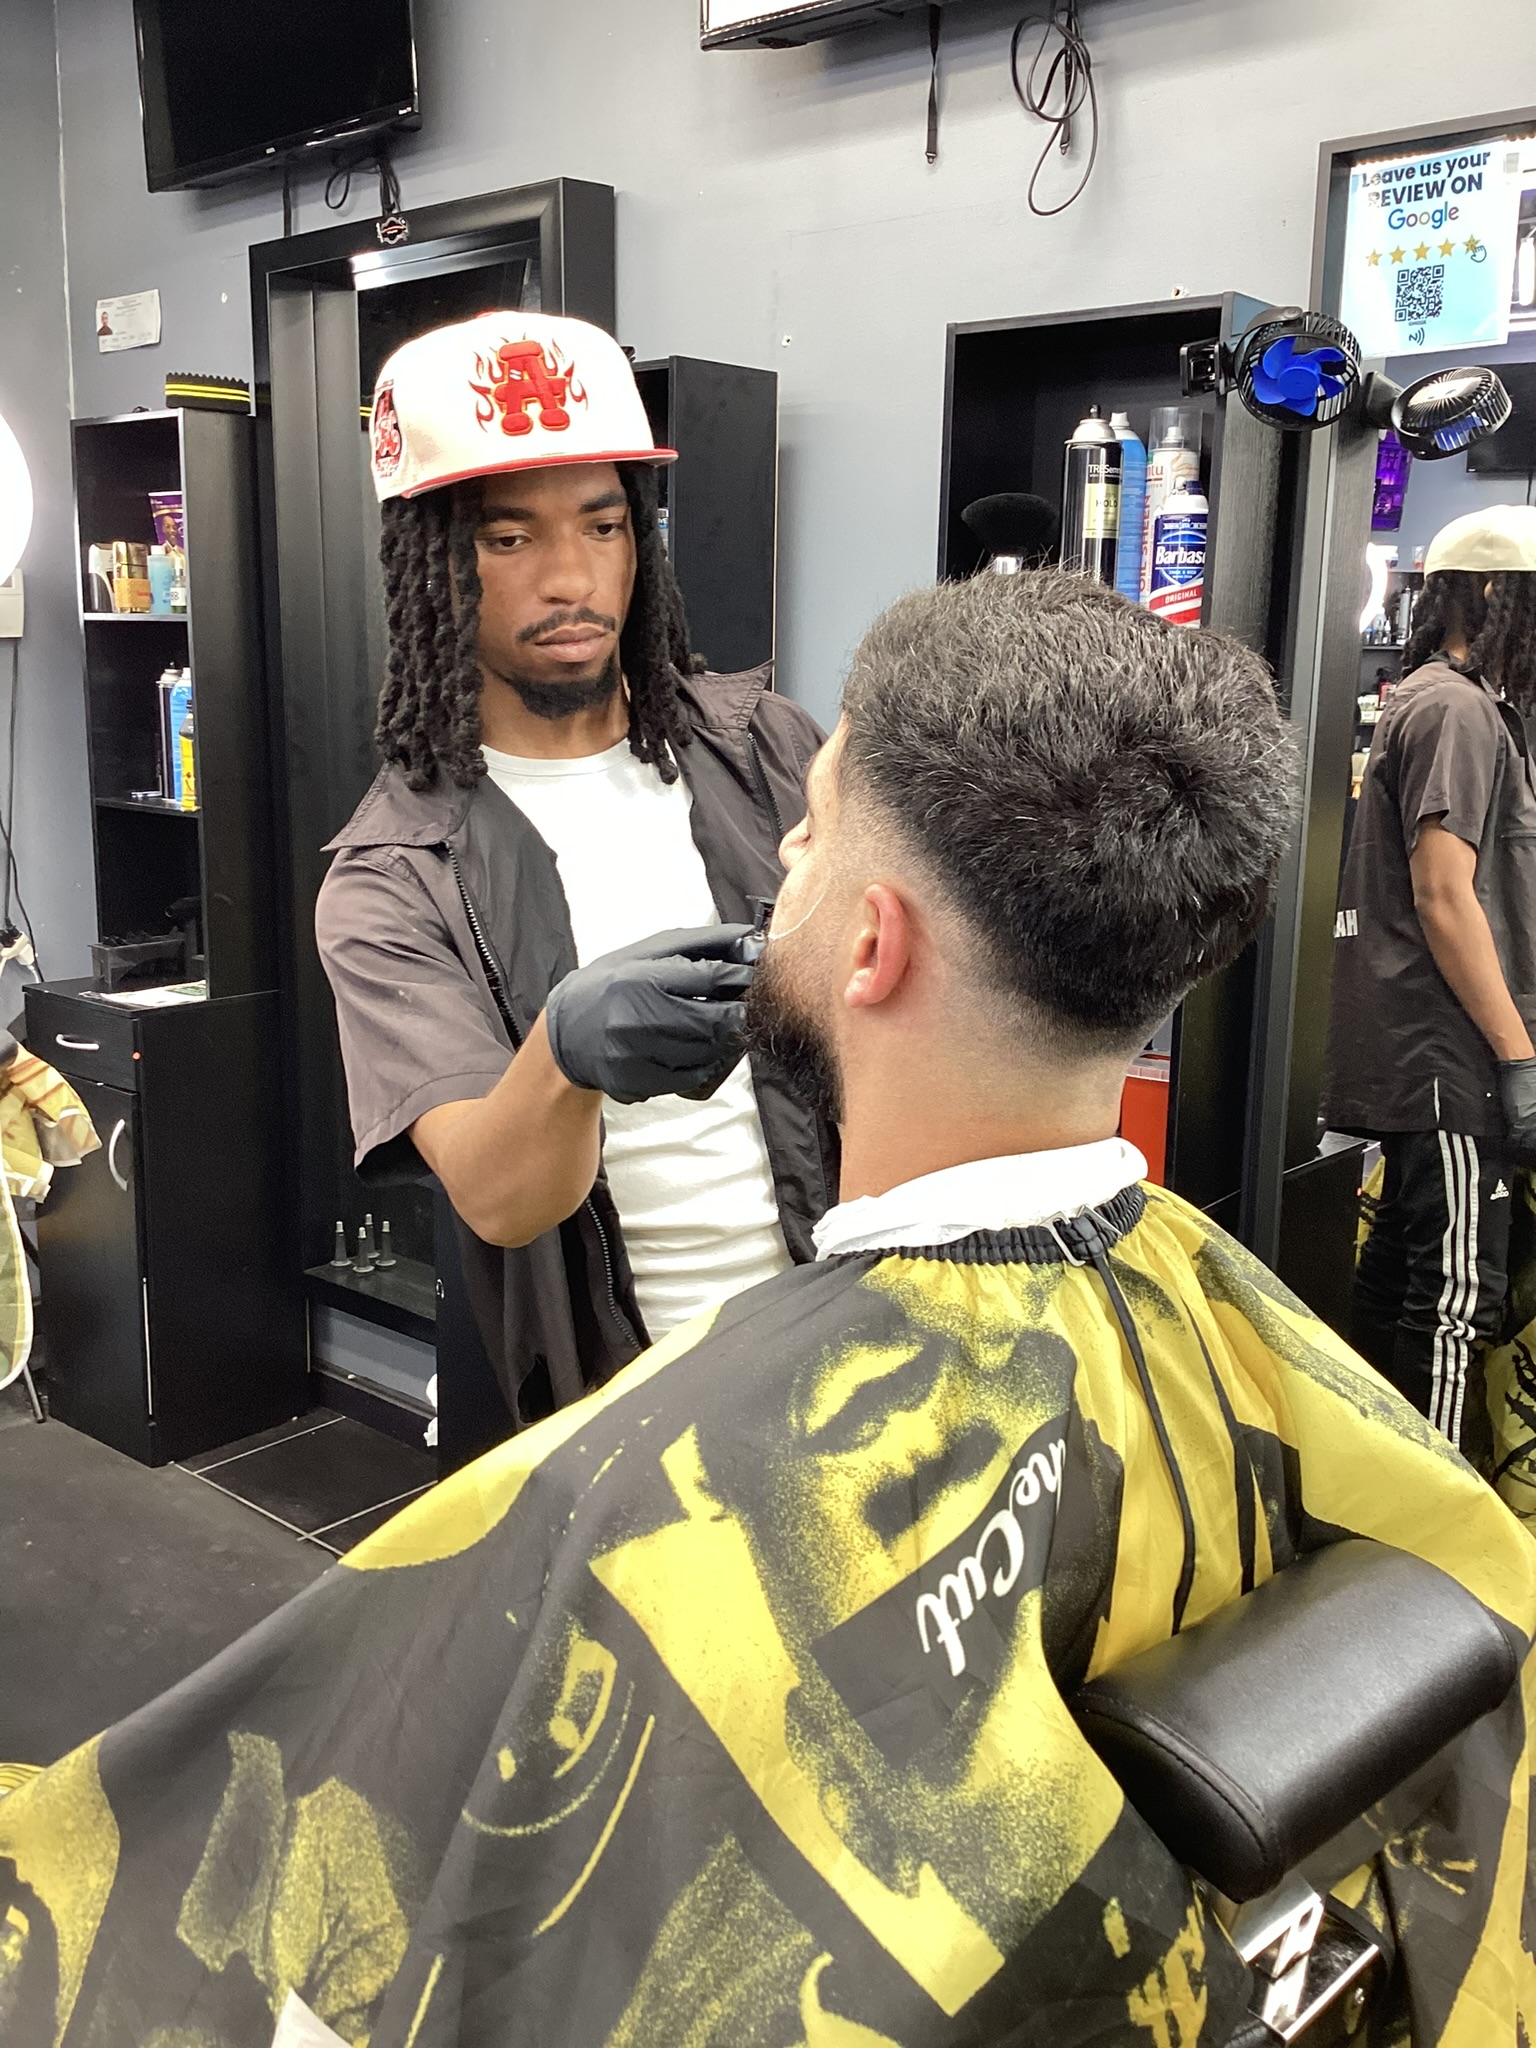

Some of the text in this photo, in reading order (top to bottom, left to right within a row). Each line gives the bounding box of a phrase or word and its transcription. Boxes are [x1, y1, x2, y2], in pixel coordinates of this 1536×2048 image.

[1362, 151, 1491, 188] Leave us your
[1450, 172, 1483, 195] ON
[1388, 201, 1460, 230] Google
[1164, 589, 1198, 604] ORIGINAL
[916, 1508, 1025, 1677] Cut
